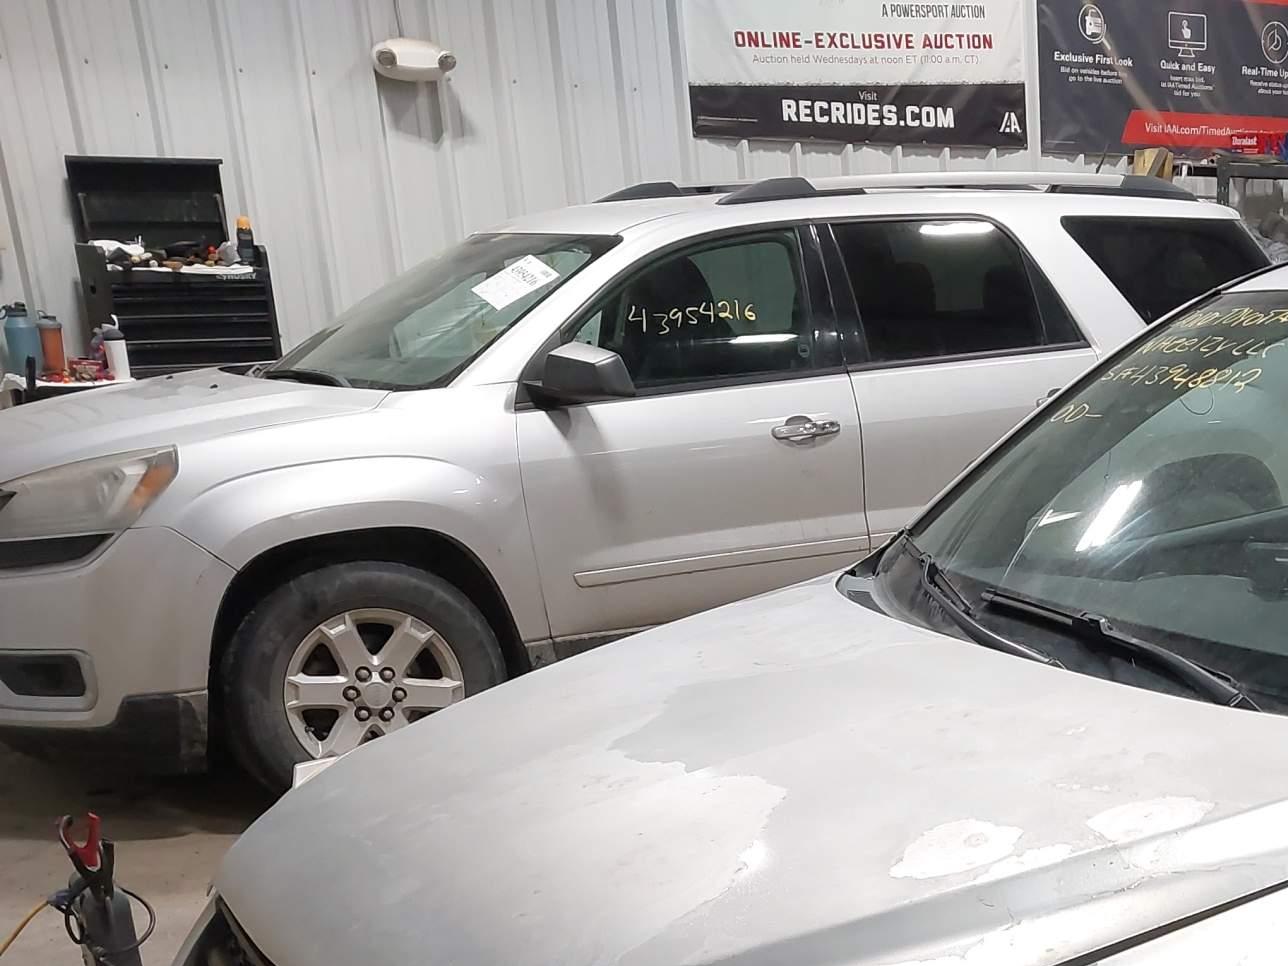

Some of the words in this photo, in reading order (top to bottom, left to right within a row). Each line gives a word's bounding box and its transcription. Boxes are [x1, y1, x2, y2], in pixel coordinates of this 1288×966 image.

[882, 4, 888, 17] A
[890, 4, 948, 18] POWERSPORT
[951, 5, 985, 18] AUCTION
[734, 31, 915, 49] ONLINE-EXCLUSIVE
[922, 34, 993, 49] AUCTION
[753, 55, 786, 64] Auction
[791, 55, 810, 64] held
[813, 55, 867, 66] Wednesdays
[881, 56, 903, 64] noon
[906, 55, 917, 64] ET
[1054, 51, 1093, 64] Exclusive
[1096, 54, 1113, 65] First
[1114, 57, 1133, 67] Look
[1160, 60, 1179, 71] Quick
[1181, 62, 1195, 71] and
[1198, 62, 1216, 74] Easy
[1242, 66, 1278, 78] Real-Time
[858, 91, 878, 101] Visit
[782, 99, 955, 128] RECRIDES.COM
[1145, 123, 1163, 133] Visit
[628, 300, 757, 334] 43954216
